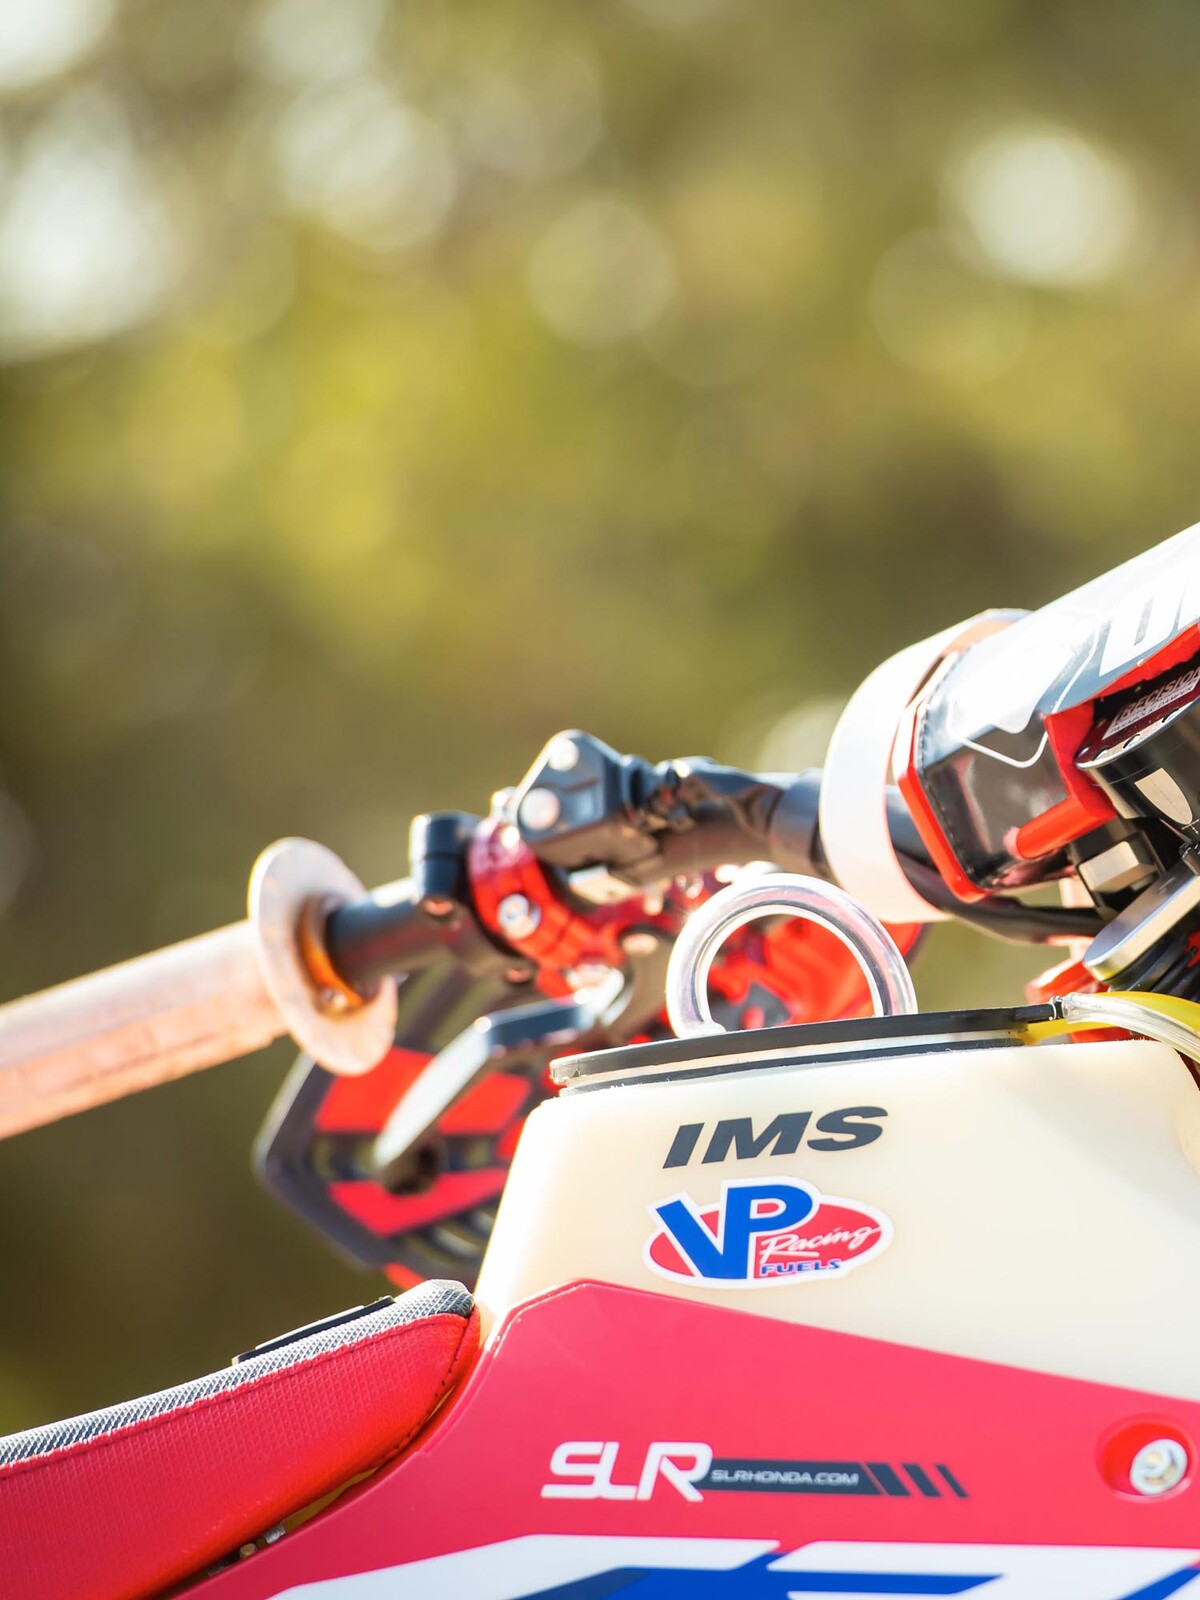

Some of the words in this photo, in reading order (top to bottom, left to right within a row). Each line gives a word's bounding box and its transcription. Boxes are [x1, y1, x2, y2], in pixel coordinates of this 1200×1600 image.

[662, 1106, 888, 1168] IMS
[655, 1184, 813, 1279] VP
[760, 1226, 881, 1264] Racing
[761, 1259, 841, 1275] FUELS
[541, 1442, 713, 1502] SLR
[711, 1469, 859, 1487] SLRHONDA.COM
